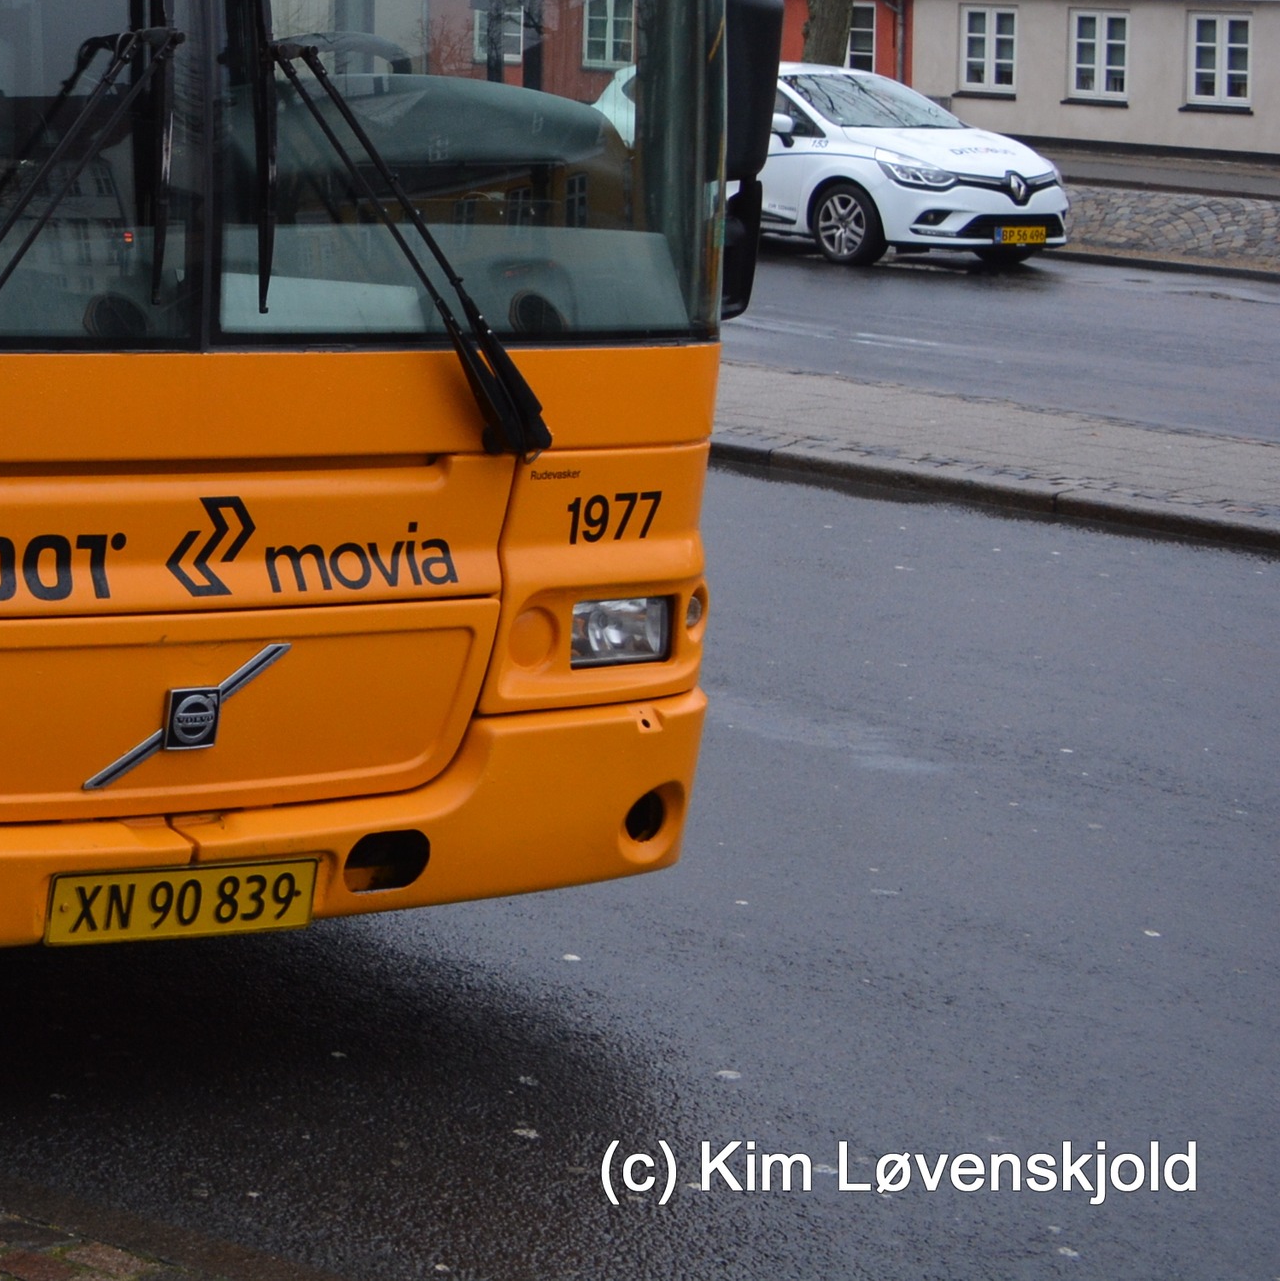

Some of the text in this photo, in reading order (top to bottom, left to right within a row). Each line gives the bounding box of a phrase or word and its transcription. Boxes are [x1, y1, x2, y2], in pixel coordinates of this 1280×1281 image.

[811, 139, 829, 149] 153
[1002, 228, 1046, 242] BP 56 496
[529, 469, 582, 481] Rudevasker
[567, 490, 663, 546] 1977
[264, 521, 459, 593] movia
[176, 714, 214, 724] VOLVO
[68, 871, 297, 934] XN 90 839
